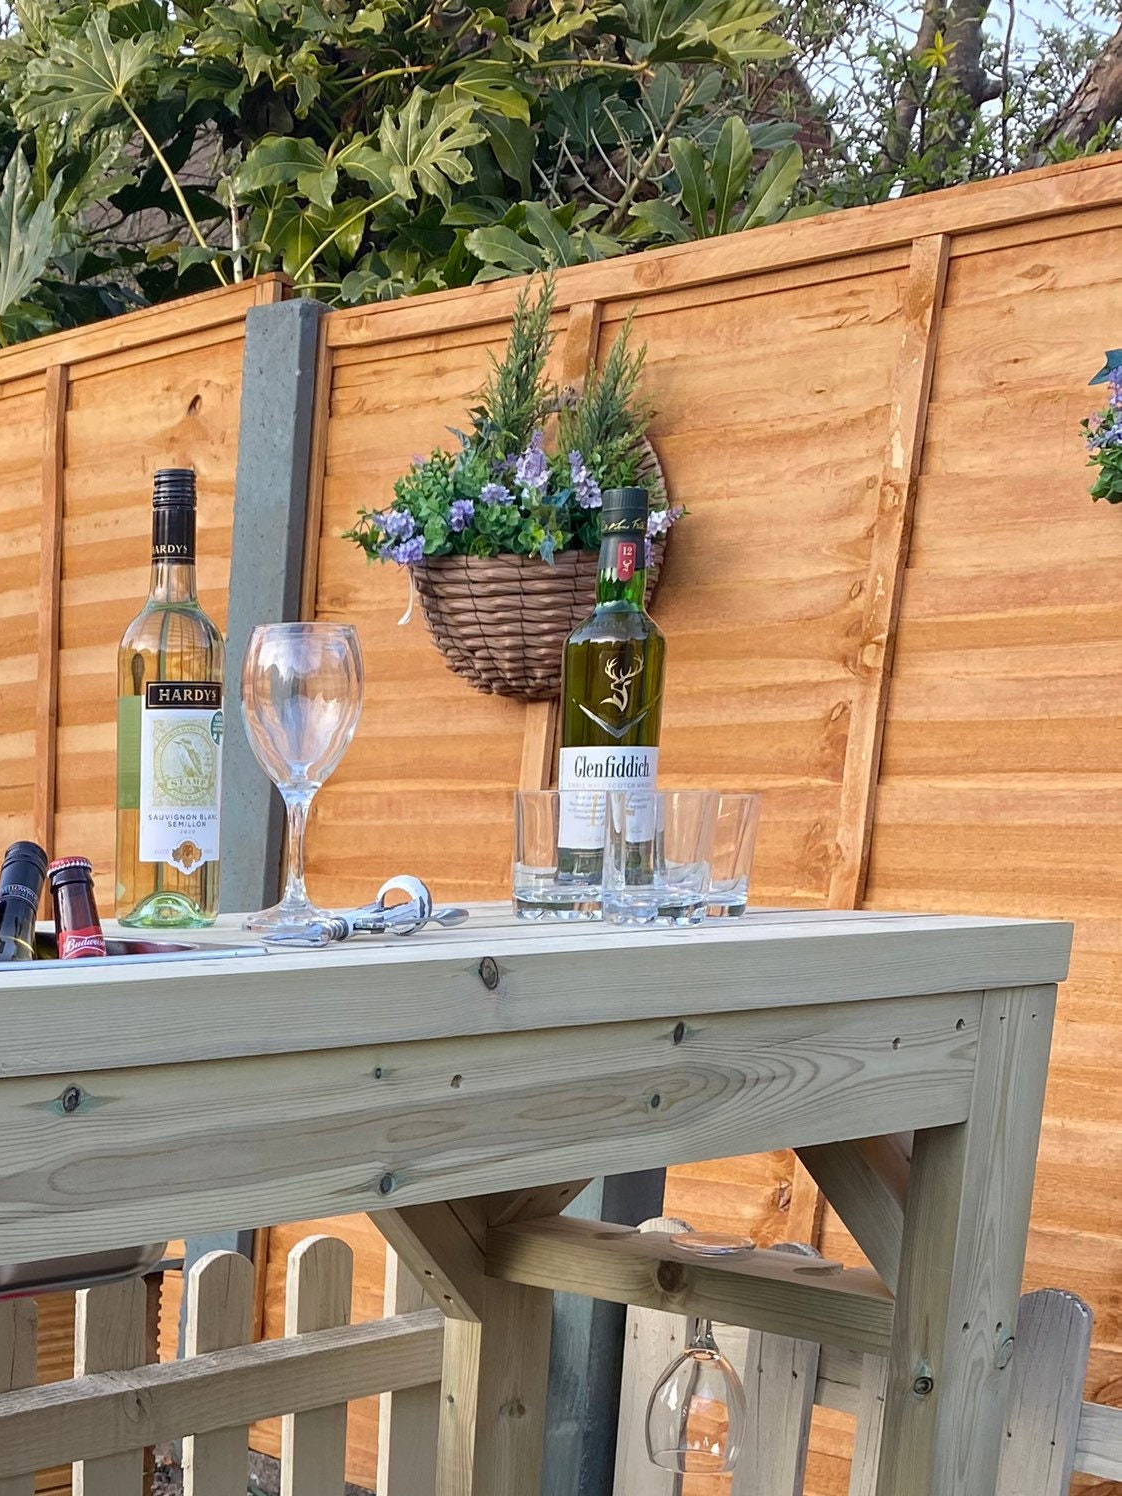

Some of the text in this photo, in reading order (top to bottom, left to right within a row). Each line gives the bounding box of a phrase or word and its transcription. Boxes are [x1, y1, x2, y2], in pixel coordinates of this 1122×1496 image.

[622, 546, 633, 556] 12
[574, 755, 650, 778] Glenfiddich
[148, 813, 198, 821] SAUVIGNON
[167, 820, 207, 828] SEMILLON
